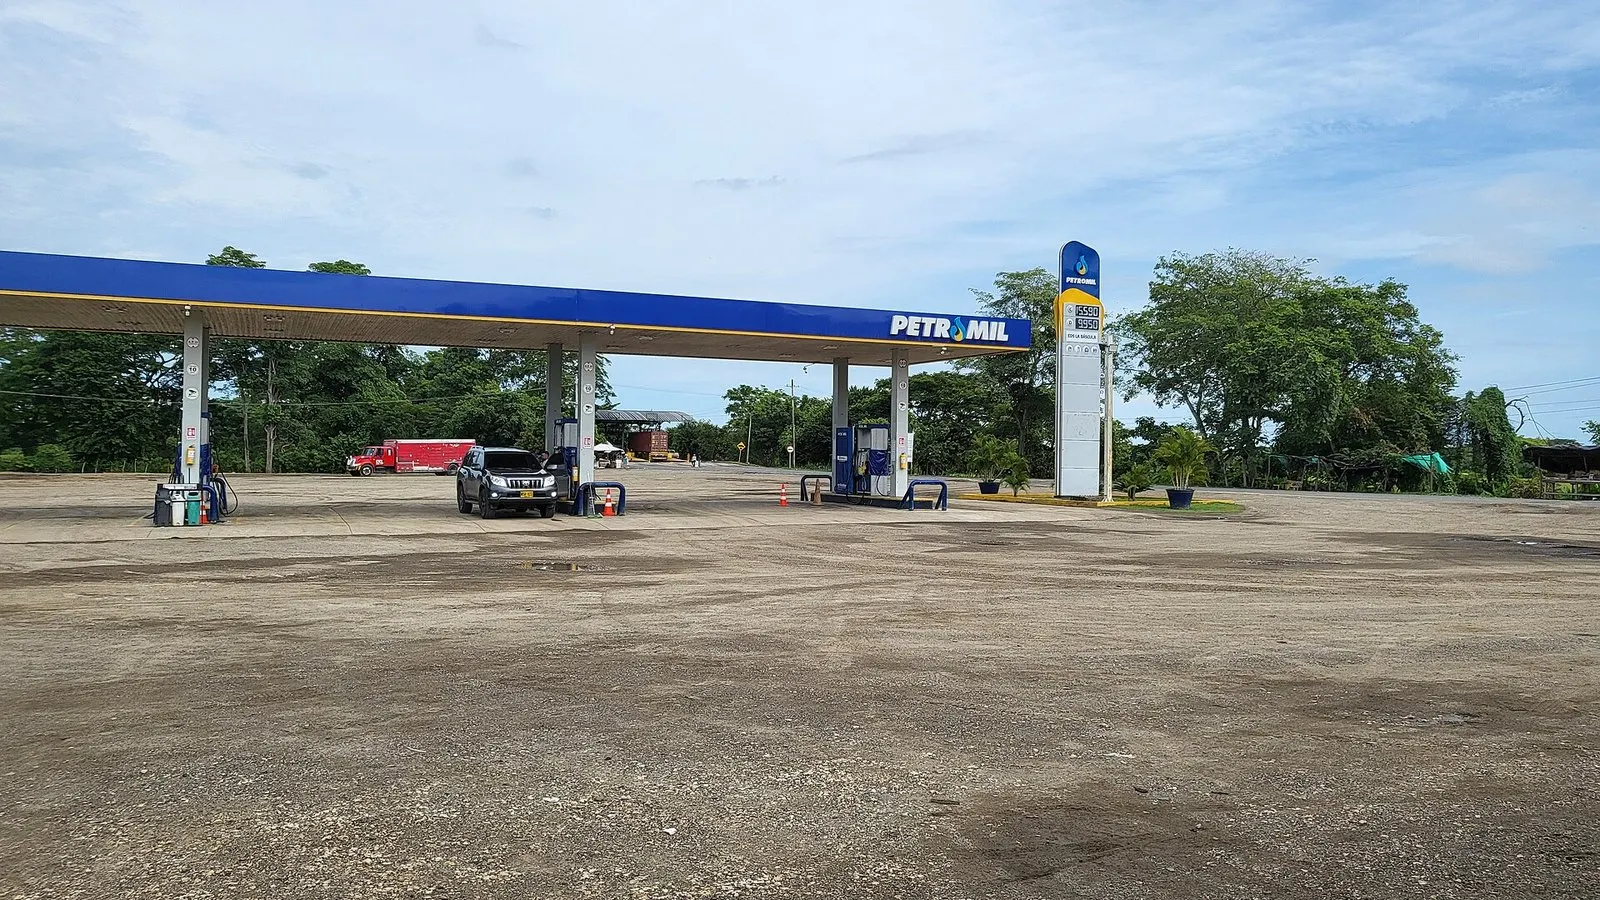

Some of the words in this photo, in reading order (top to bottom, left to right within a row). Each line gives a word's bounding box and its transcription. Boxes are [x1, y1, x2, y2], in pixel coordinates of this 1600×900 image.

[1066, 277, 1096, 285] PETROMIL
[1076, 306, 1099, 316] 15590
[1078, 319, 1098, 329] 9950
